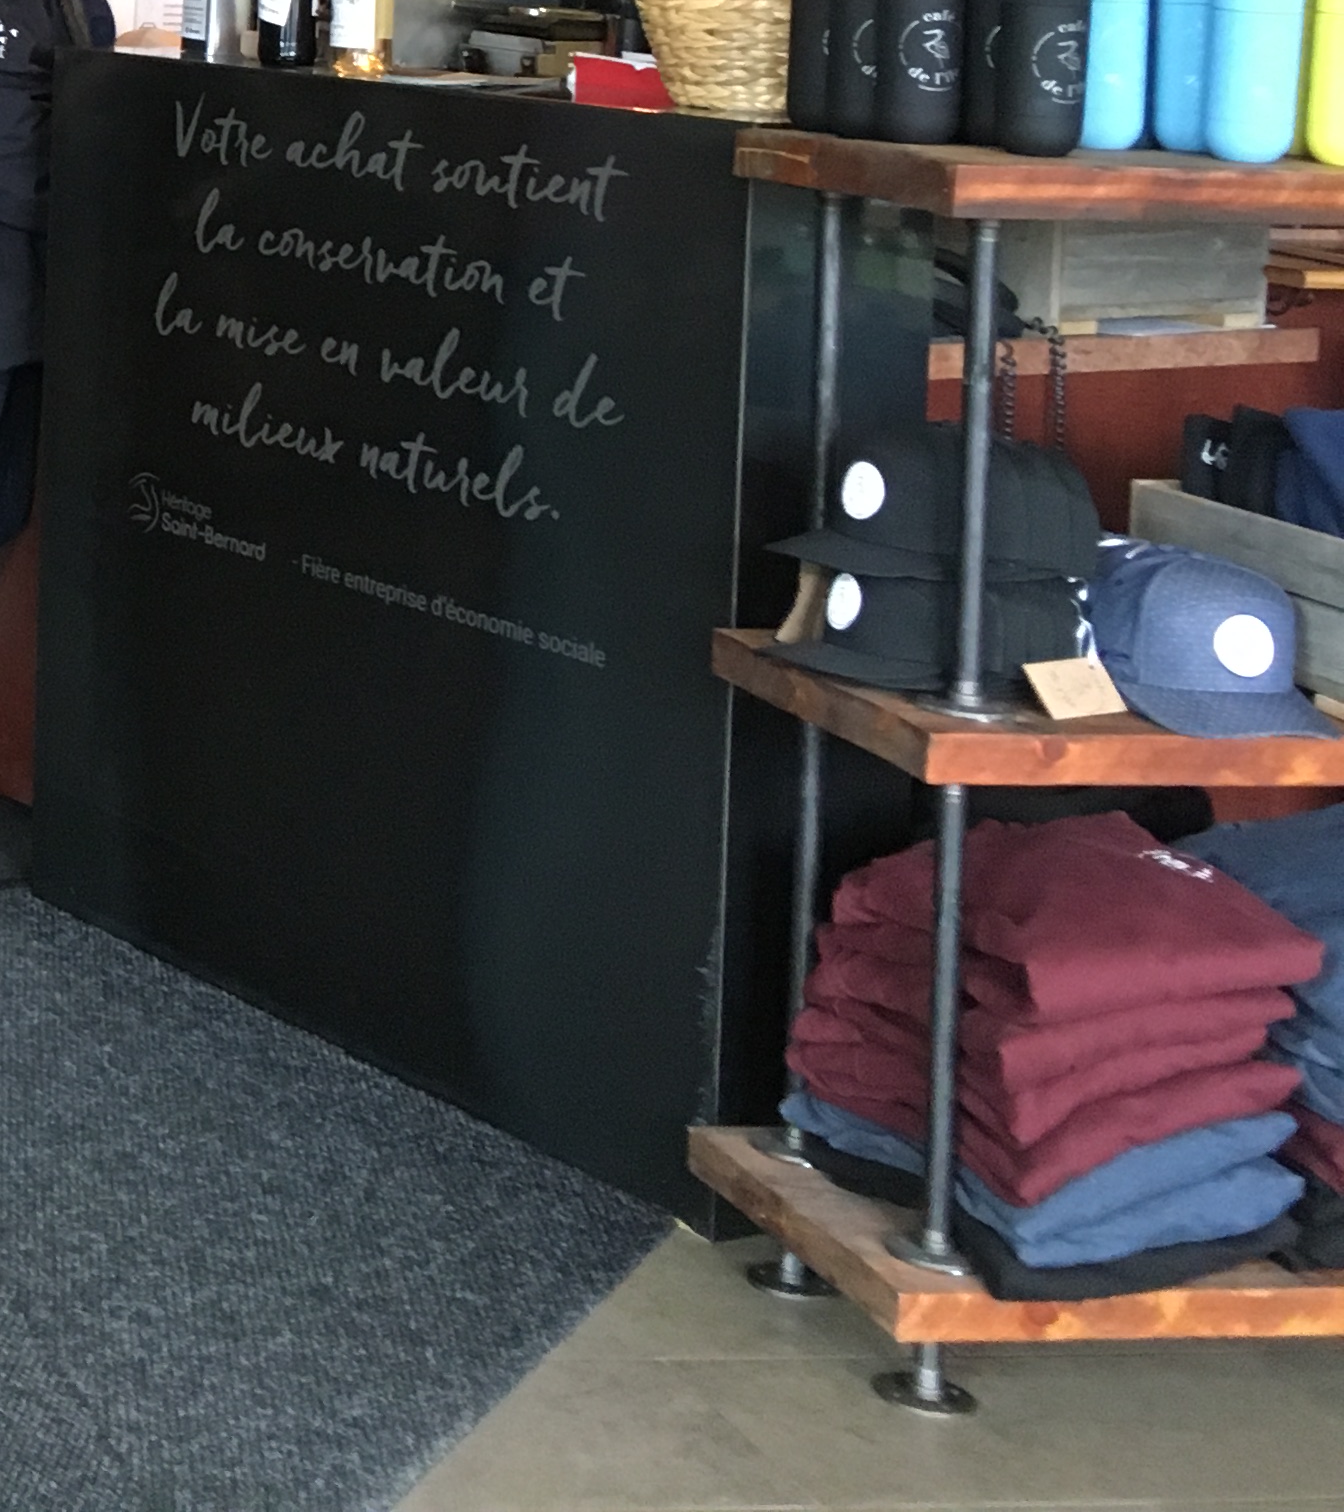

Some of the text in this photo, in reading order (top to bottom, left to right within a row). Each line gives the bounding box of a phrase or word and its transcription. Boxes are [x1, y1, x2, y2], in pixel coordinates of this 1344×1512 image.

[173, 91, 631, 223] Votre achat soutient
[194, 186, 587, 323] la conservation et
[154, 271, 626, 431] la mise en valeur de
[191, 382, 564, 522] milieux naturels.
[161, 511, 267, 562] Saint-Bernard
[301, 553, 341, 585] Fière
[344, 571, 427, 613] entreprise
[430, 592, 535, 645] d'économie
[537, 630, 608, 668] sociale
